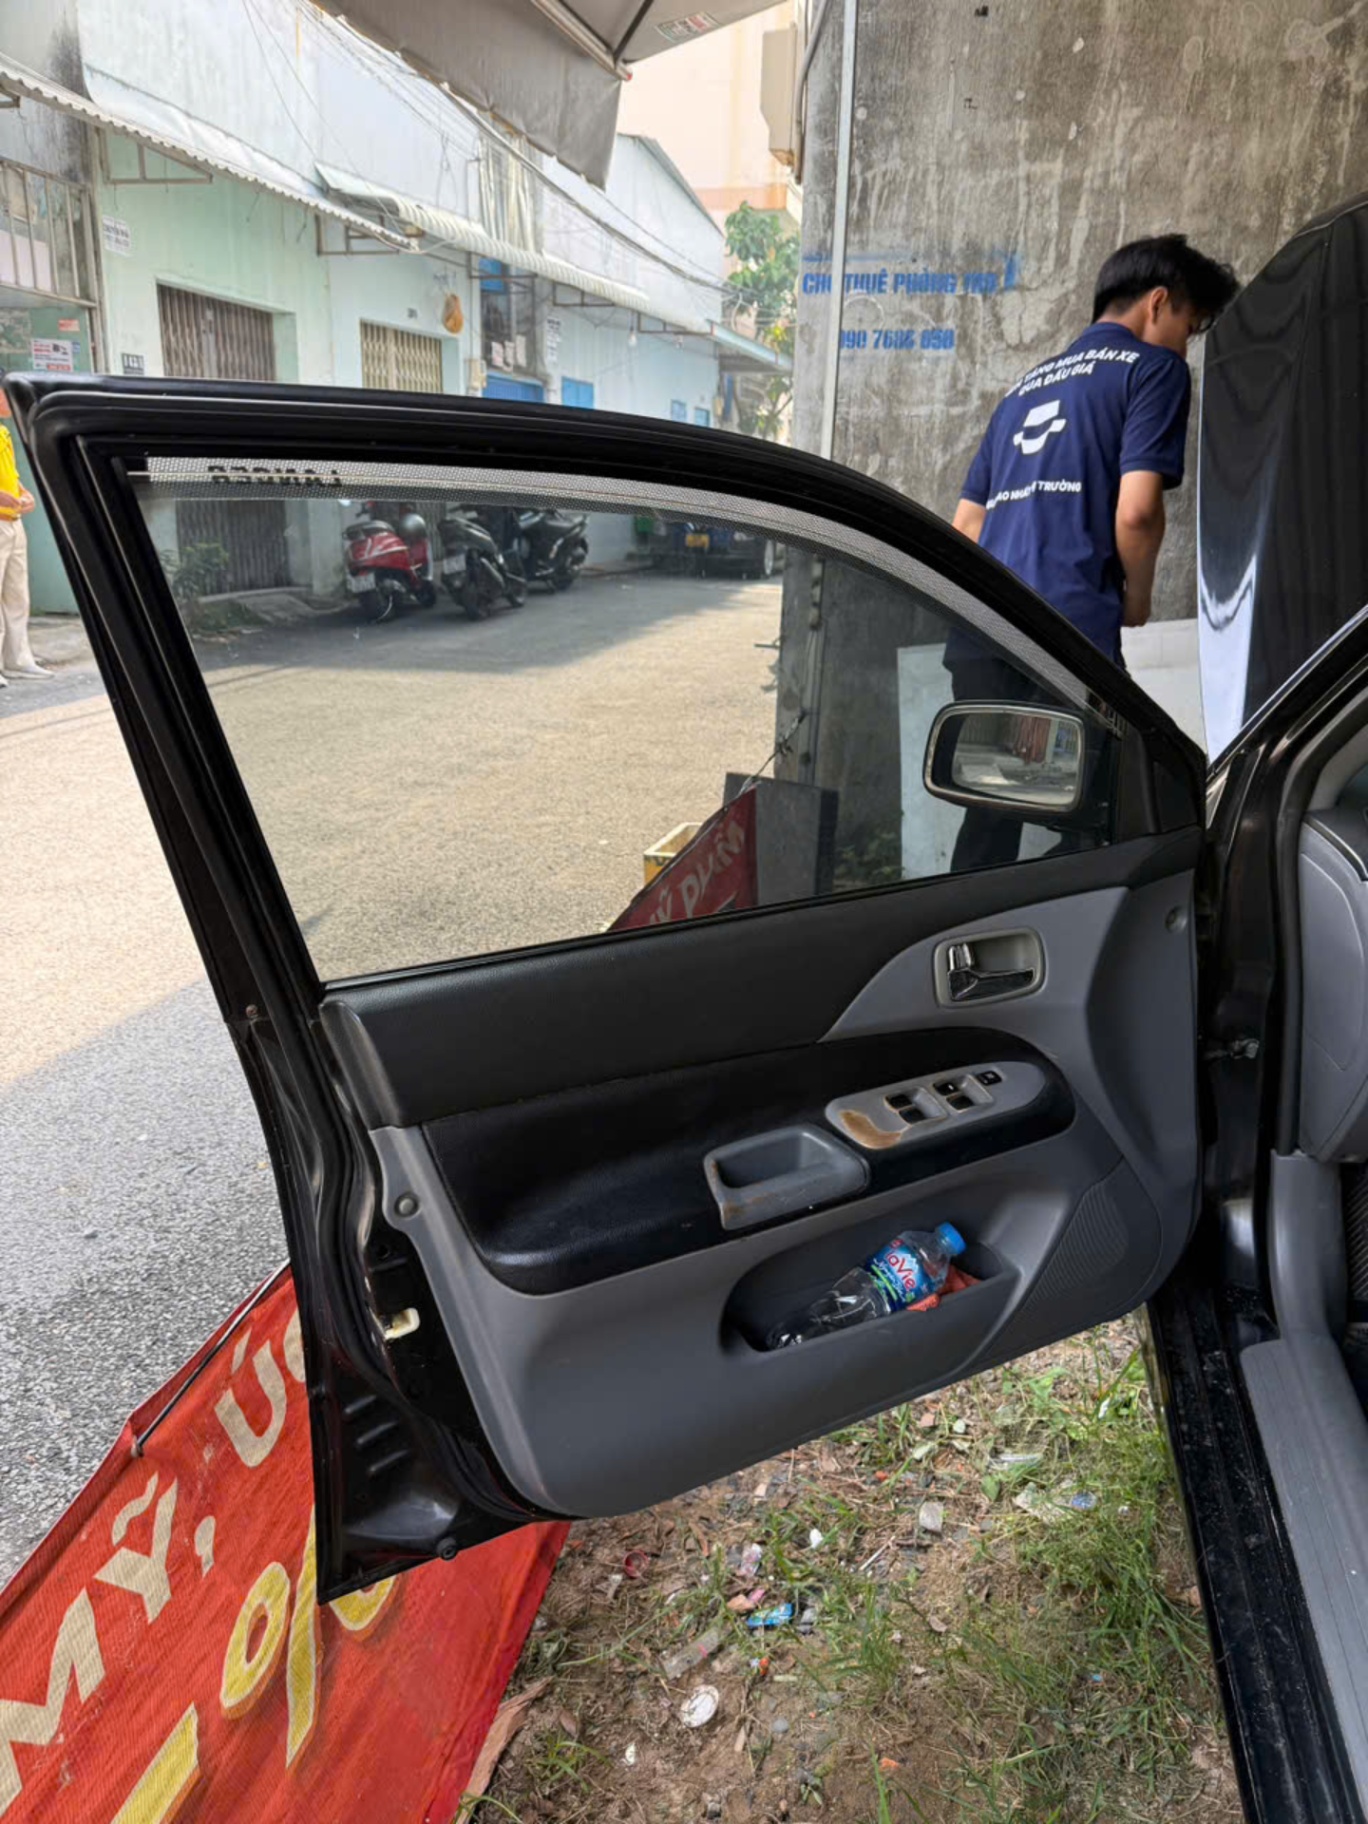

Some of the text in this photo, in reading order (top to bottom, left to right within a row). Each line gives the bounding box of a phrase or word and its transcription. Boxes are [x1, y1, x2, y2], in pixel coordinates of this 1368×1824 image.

[845, 267, 889, 295] THUÊ
[1055, 351, 1085, 371] MUA
[1085, 346, 1116, 361] BÁN
[1114, 350, 1140, 365] XE
[1071, 360, 1096, 377] GIÁ
[1038, 478, 1082, 493] TRƯỜNG
